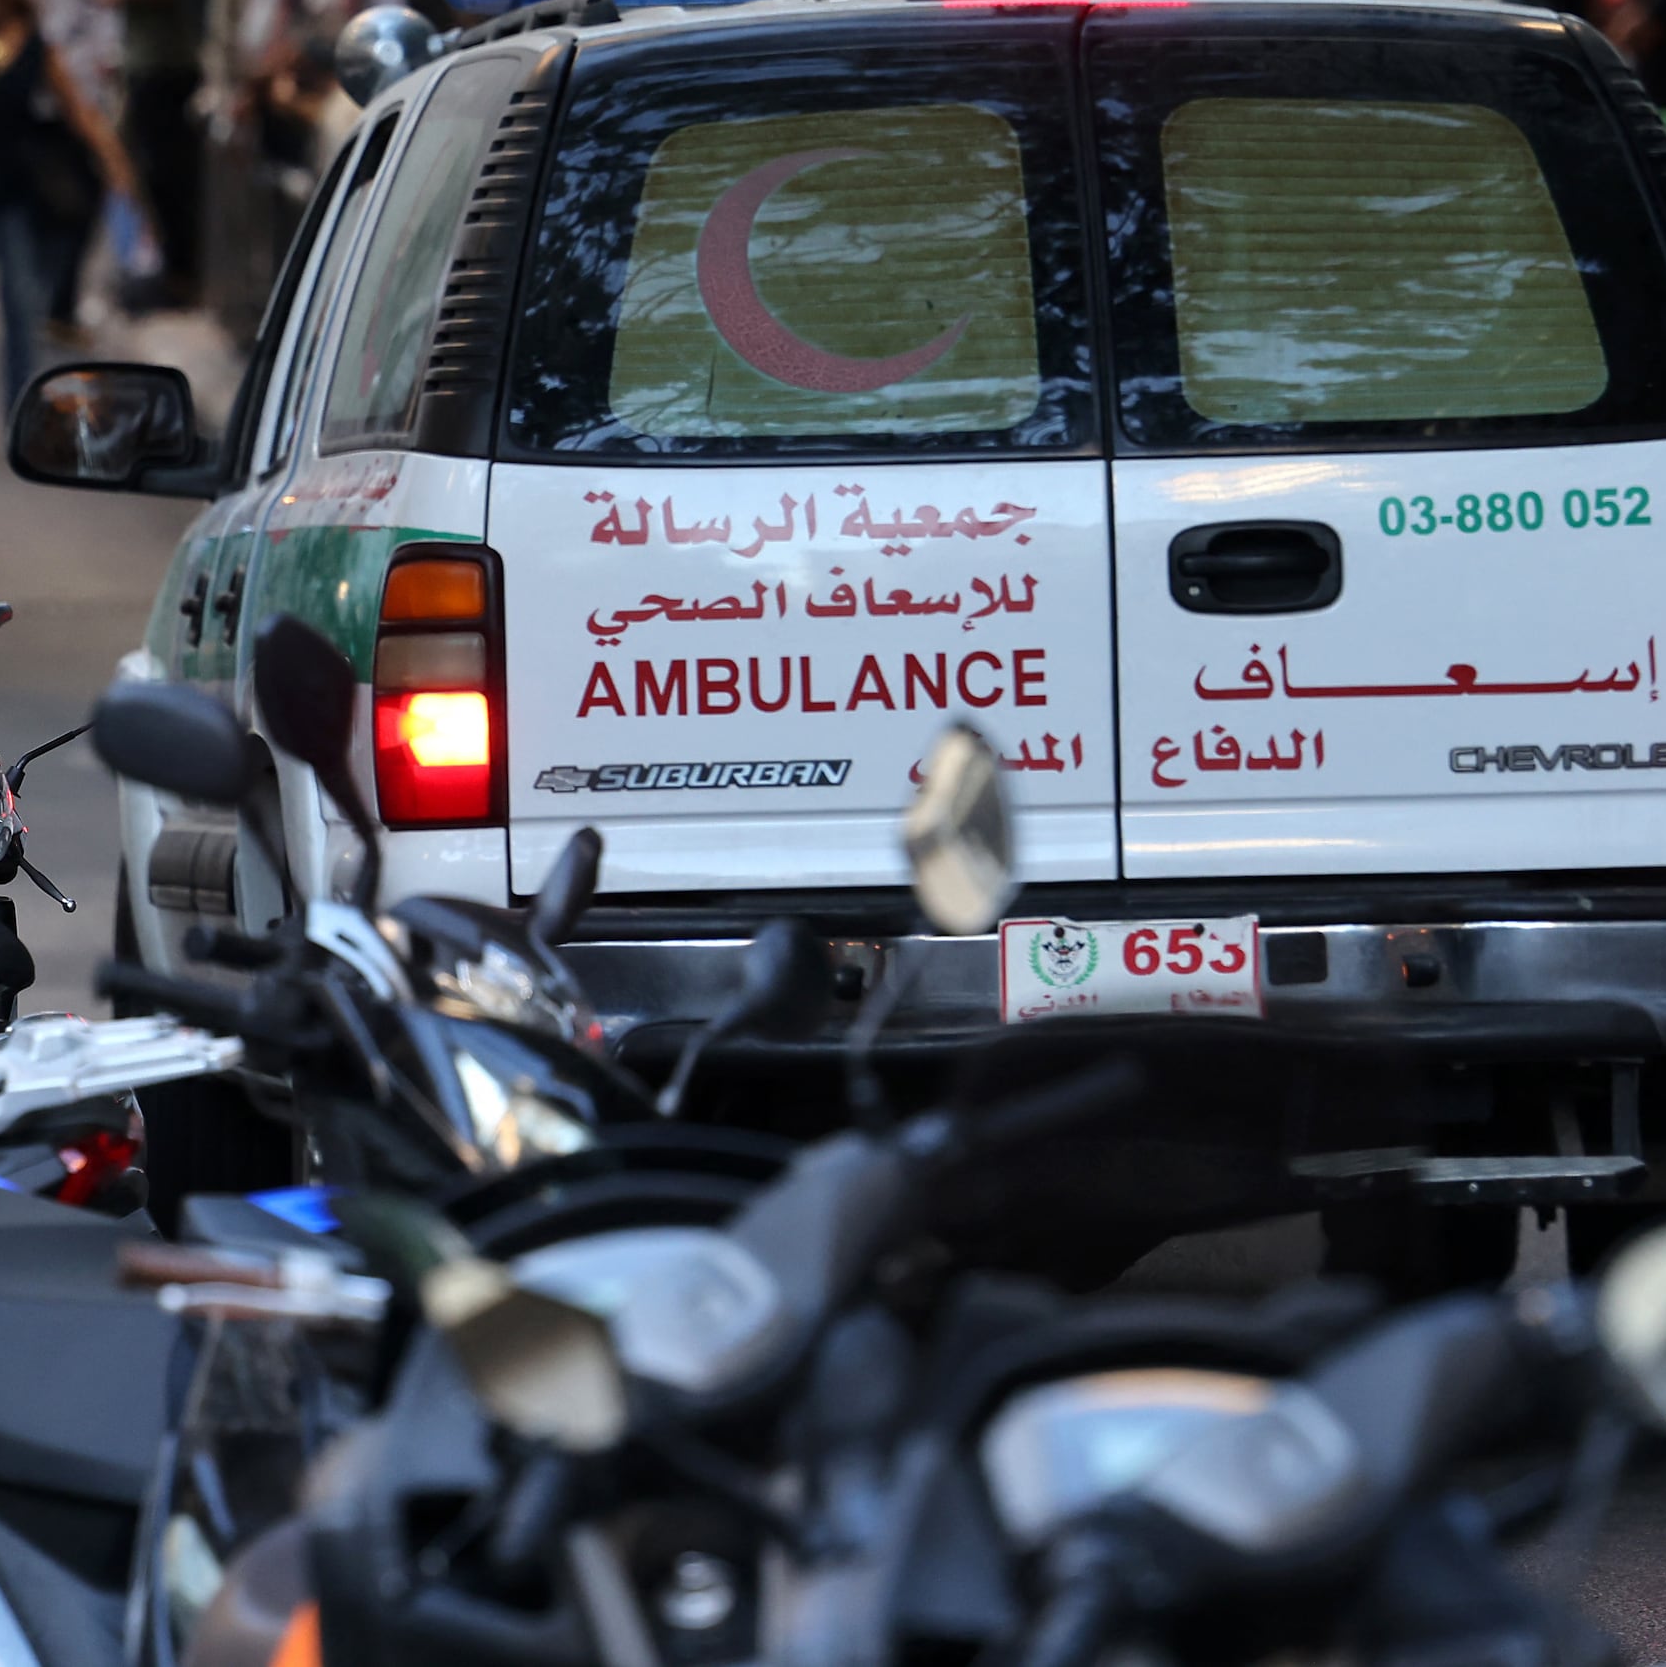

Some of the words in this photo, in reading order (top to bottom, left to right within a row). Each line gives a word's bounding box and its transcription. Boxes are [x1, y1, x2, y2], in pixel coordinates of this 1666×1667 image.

[584, 491, 816, 558] الرسالة
[839, 484, 1037, 556] جمعية
[1377, 490, 1544, 537] 03-880
[1560, 484, 1653, 530] 052
[586, 580, 787, 647] الصحي
[806, 566, 1039, 631] للإسعاف
[576, 648, 1048, 718] AMBULANCE
[592, 759, 852, 791] SUBURBAN
[1151, 725, 1324, 788] الدفاع
